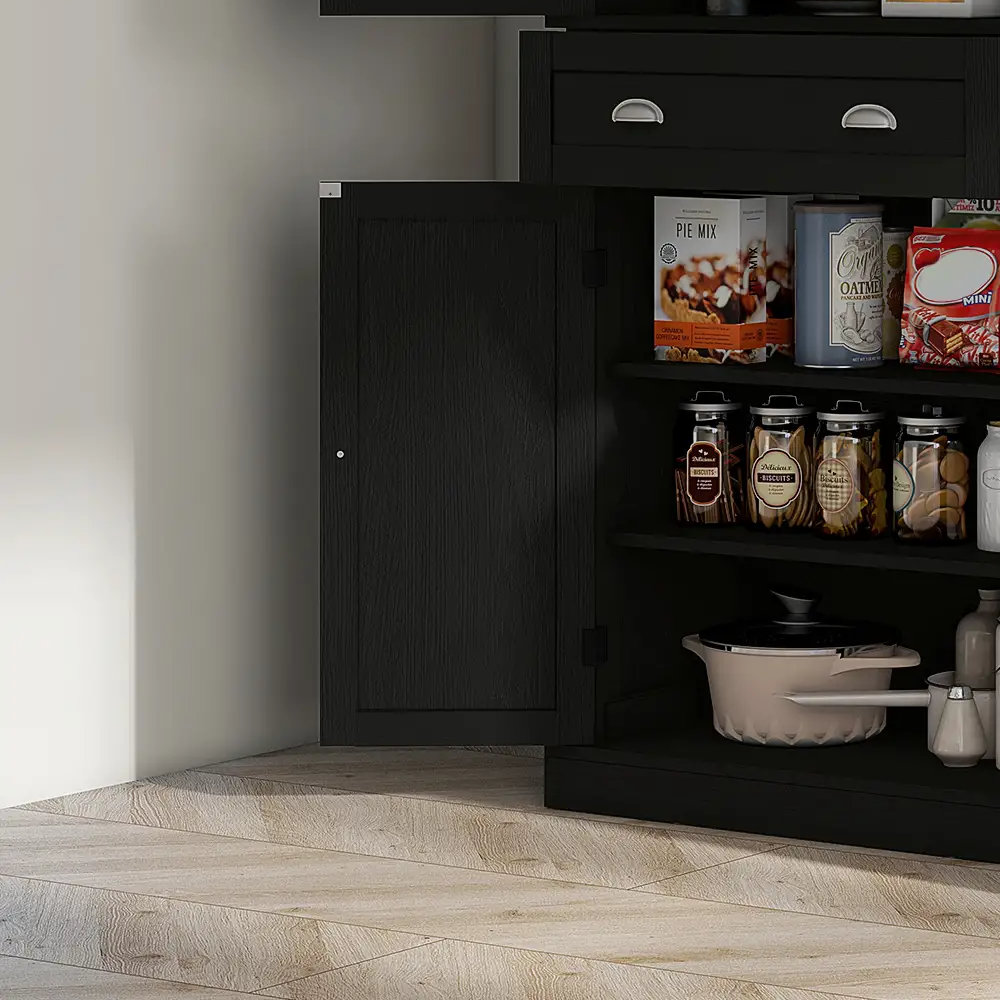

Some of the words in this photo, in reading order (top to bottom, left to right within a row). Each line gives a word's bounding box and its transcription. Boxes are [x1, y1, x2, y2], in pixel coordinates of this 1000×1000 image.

[676, 222, 693, 238] PIE
[698, 223, 717, 239] MIX
[748, 247, 758, 269] MIX
[840, 280, 883, 295] OATME
[762, 474, 791, 482] BISCUITS
[820, 474, 849, 483] Biscuits
